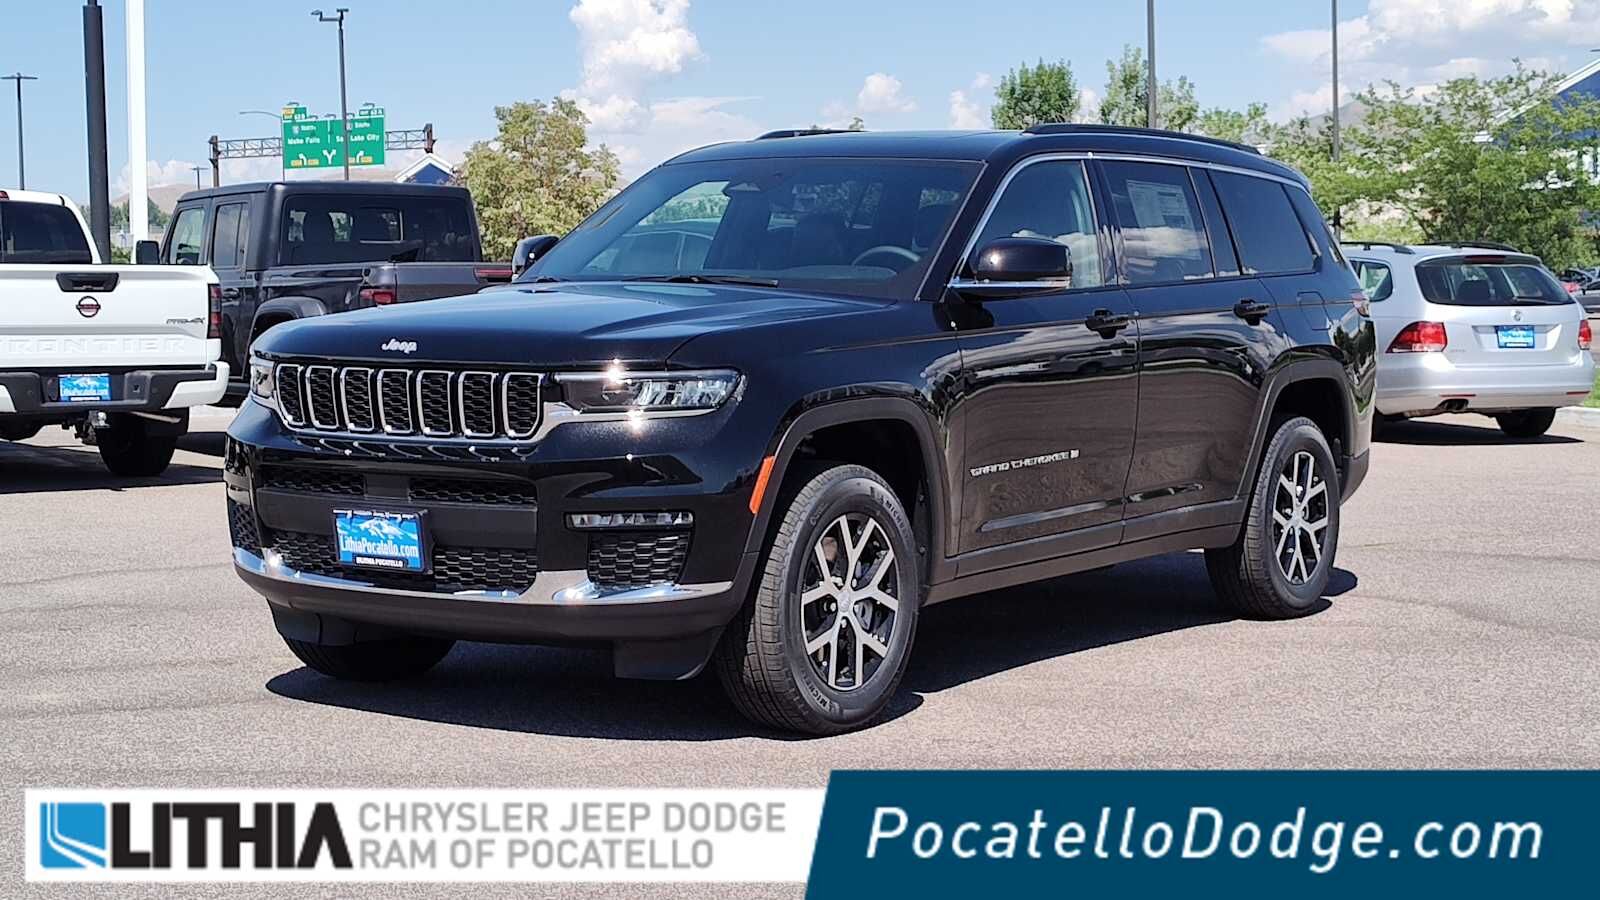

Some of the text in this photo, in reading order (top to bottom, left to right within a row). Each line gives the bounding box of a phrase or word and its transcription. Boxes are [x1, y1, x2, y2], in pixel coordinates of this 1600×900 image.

[305, 136, 320, 144] Falls
[366, 133, 380, 142] City
[381, 339, 417, 354] Jeep
[970, 462, 1010, 477] GRAND
[1010, 451, 1070, 469] CHEROKEE
[339, 534, 419, 558] LithiaPocatello.com
